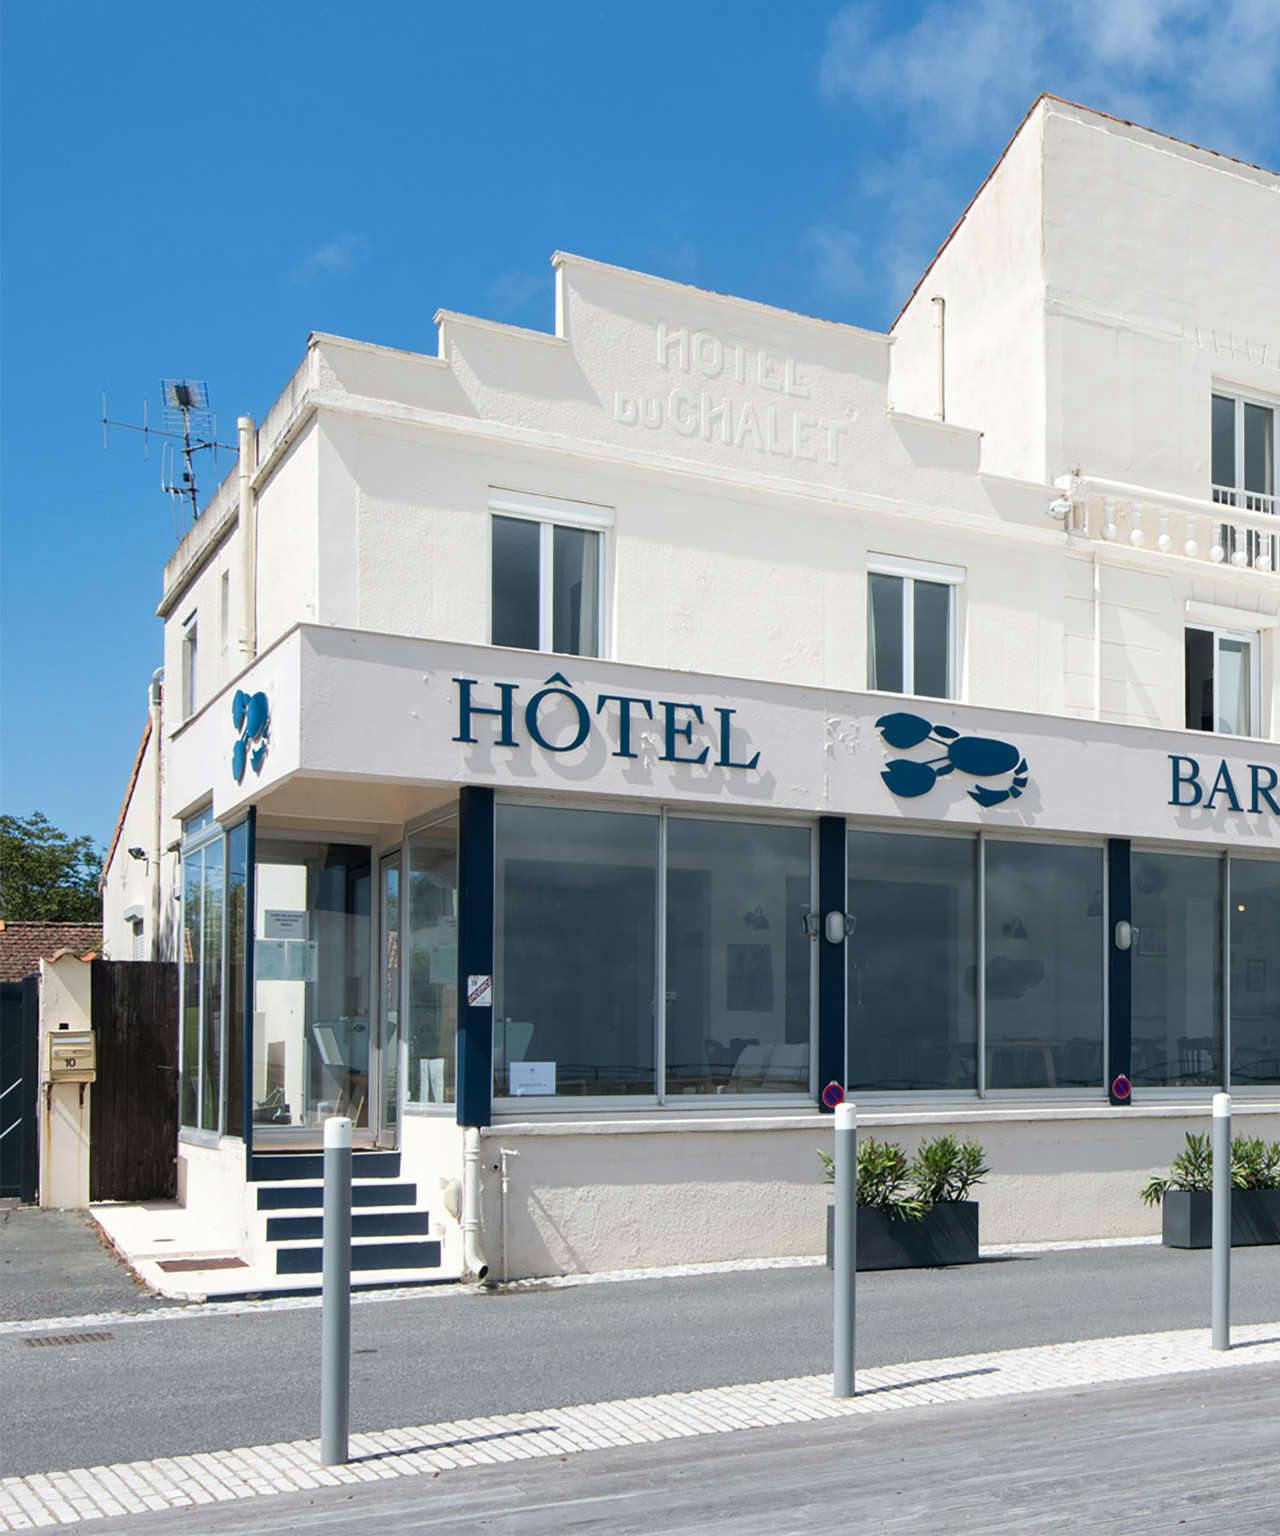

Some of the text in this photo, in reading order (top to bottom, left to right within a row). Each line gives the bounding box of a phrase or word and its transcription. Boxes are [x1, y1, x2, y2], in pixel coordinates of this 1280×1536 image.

[656, 321, 810, 400] HOTEL
[614, 386, 848, 466] DU CHALET
[453, 672, 761, 770] HÔTEL
[64, 1057, 76, 1067] 10
